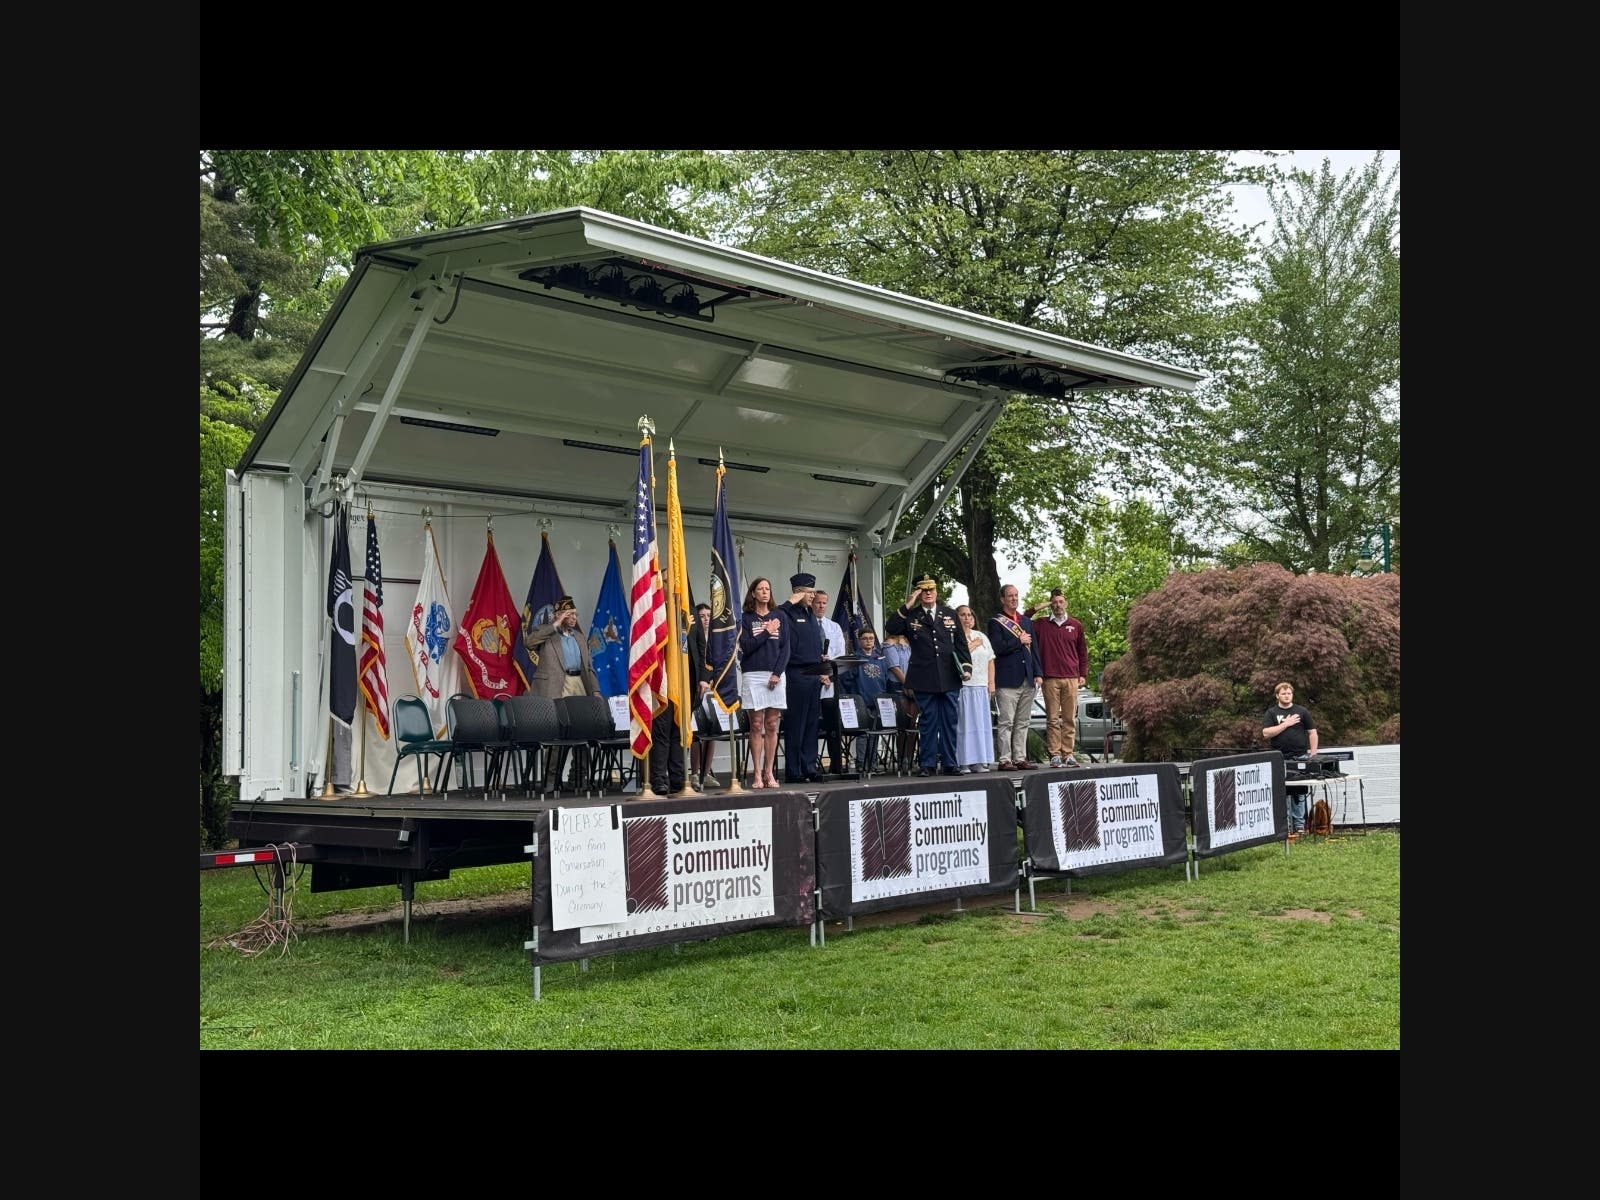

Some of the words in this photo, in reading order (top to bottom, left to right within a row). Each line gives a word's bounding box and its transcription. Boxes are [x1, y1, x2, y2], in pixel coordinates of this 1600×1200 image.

[1236, 765, 1261, 786] summit
[1100, 777, 1140, 801] summit
[1237, 784, 1272, 806] community
[914, 794, 963, 821] summit
[1101, 799, 1160, 824] community
[1238, 807, 1270, 830] programs
[561, 812, 606, 835] PLEASE
[672, 812, 740, 845] summit
[915, 817, 987, 847] community
[1103, 824, 1155, 850] programs
[673, 839, 772, 875] community
[916, 847, 980, 878] programs
[592, 879, 607, 890] the
[673, 874, 762, 912] programs
[595, 928, 637, 941] WHERE
[647, 917, 717, 933] COMMUNITY
[725, 910, 771, 922] THRIVES
